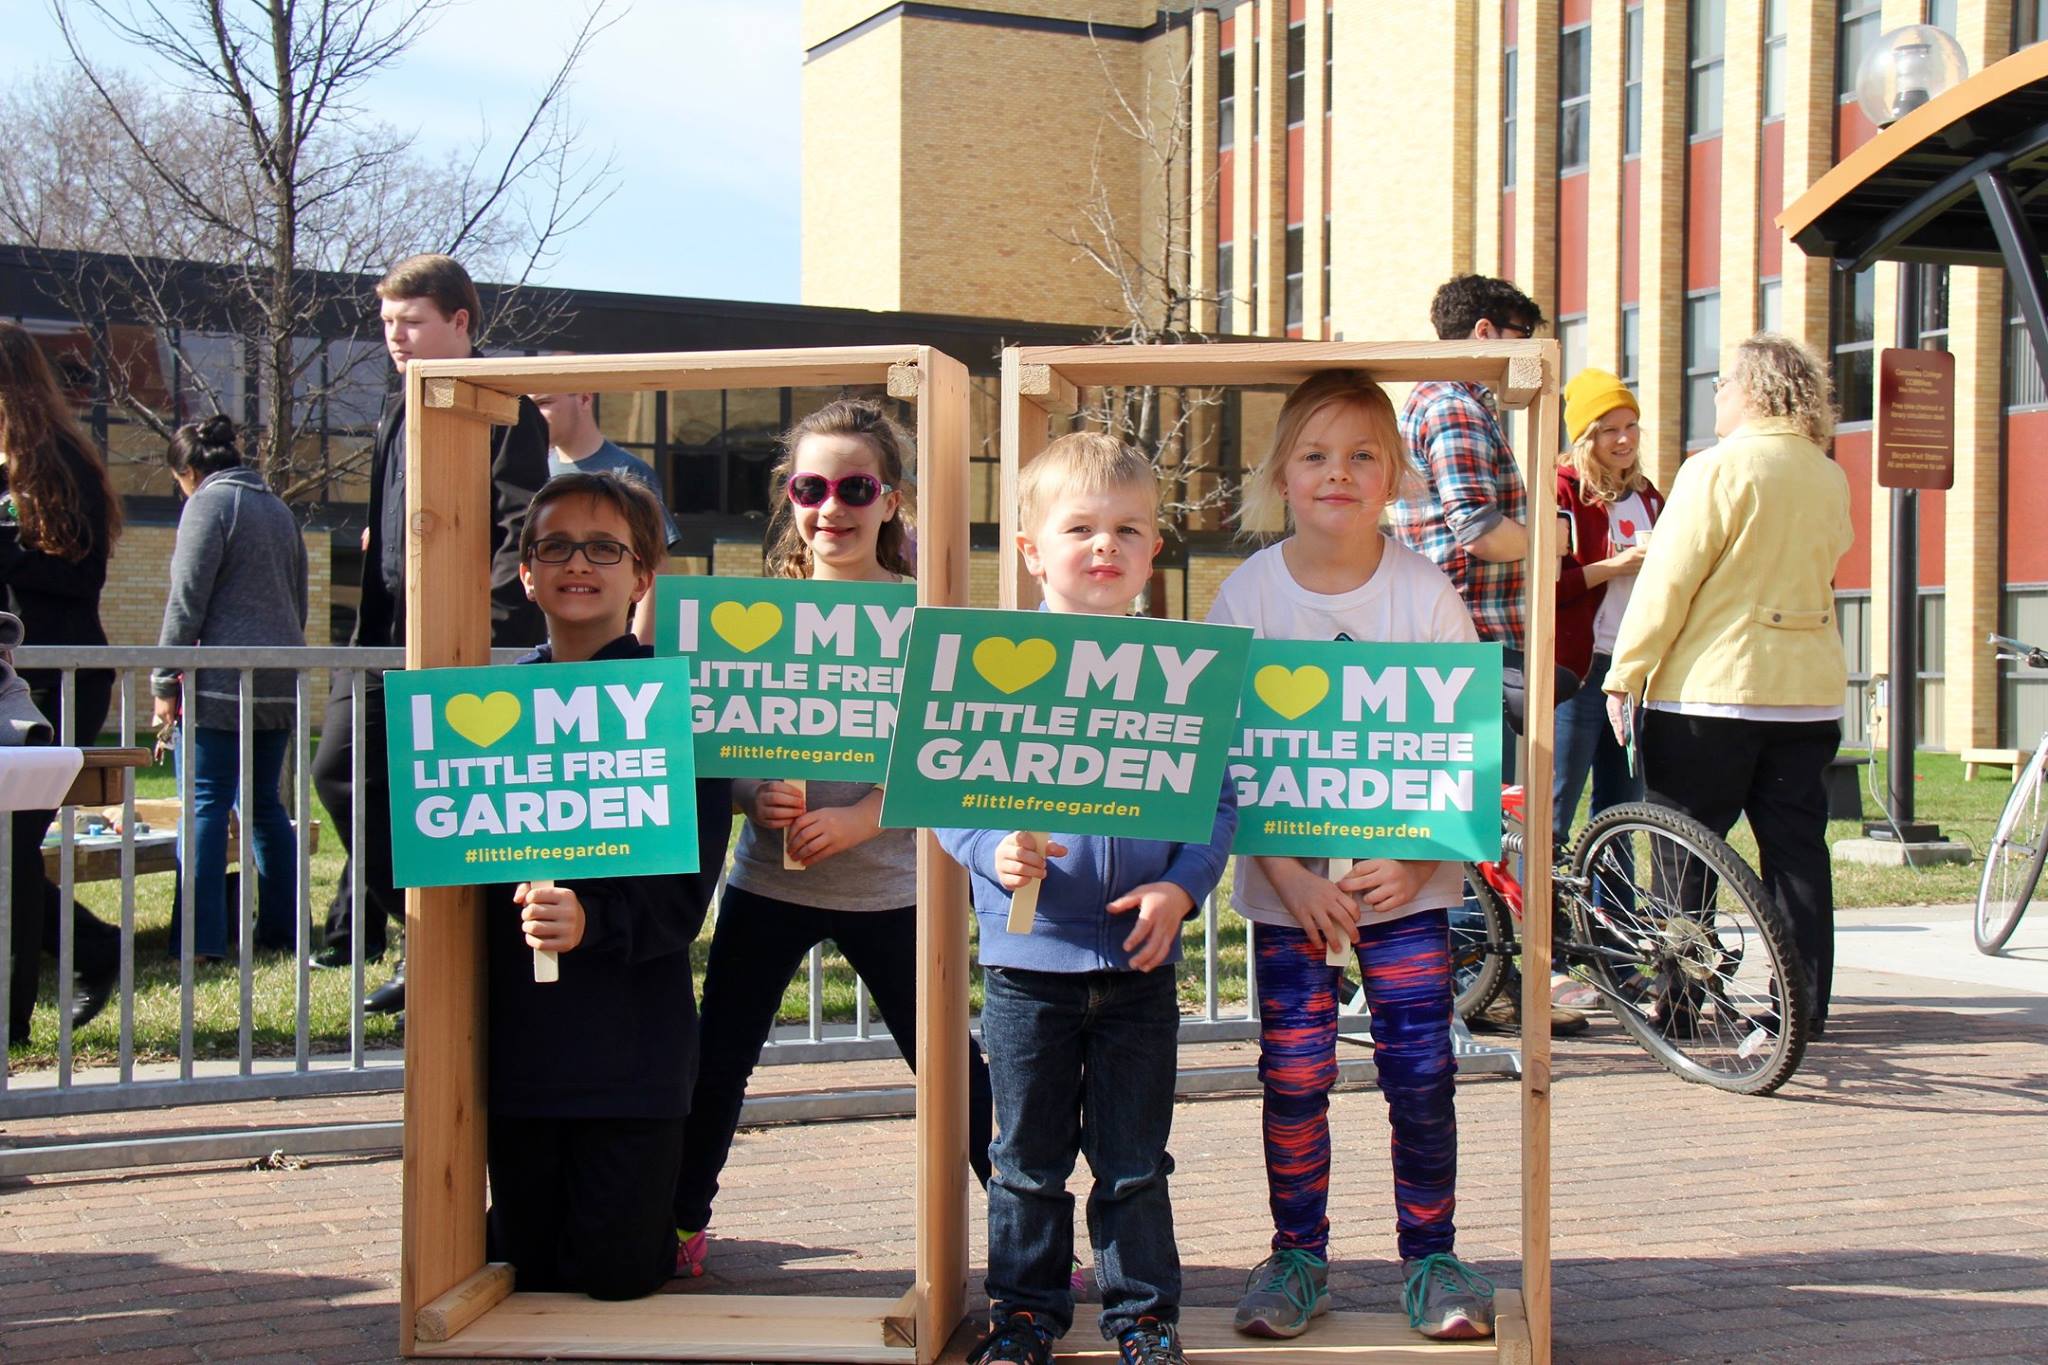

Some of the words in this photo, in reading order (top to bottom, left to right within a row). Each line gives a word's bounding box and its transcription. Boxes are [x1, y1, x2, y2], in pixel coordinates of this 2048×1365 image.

[679, 599, 699, 652] I
[794, 602, 914, 659] MY
[689, 660, 809, 690] ITTLE
[930, 633, 962, 692] I
[1064, 640, 1220, 706] MY
[1342, 665, 1476, 723] MY
[411, 694, 434, 751] I
[533, 682, 664, 745] MY
[923, 700, 1079, 737] LITTLE
[1086, 708, 1204, 745] FREE
[719, 745, 875, 763] #littlefreegarden
[916, 737, 1197, 794] GARDEN
[1228, 728, 1357, 760] ITTLE
[1368, 732, 1473, 762] FREE
[413, 754, 553, 789] LITTLE
[563, 748, 667, 781] FREE
[415, 784, 670, 838] GARDEN
[961, 793, 1141, 817] #littlefreegarden
[1264, 820, 1431, 839] #littlefreegarden
[464, 842, 631, 864] #littlefreegarden
